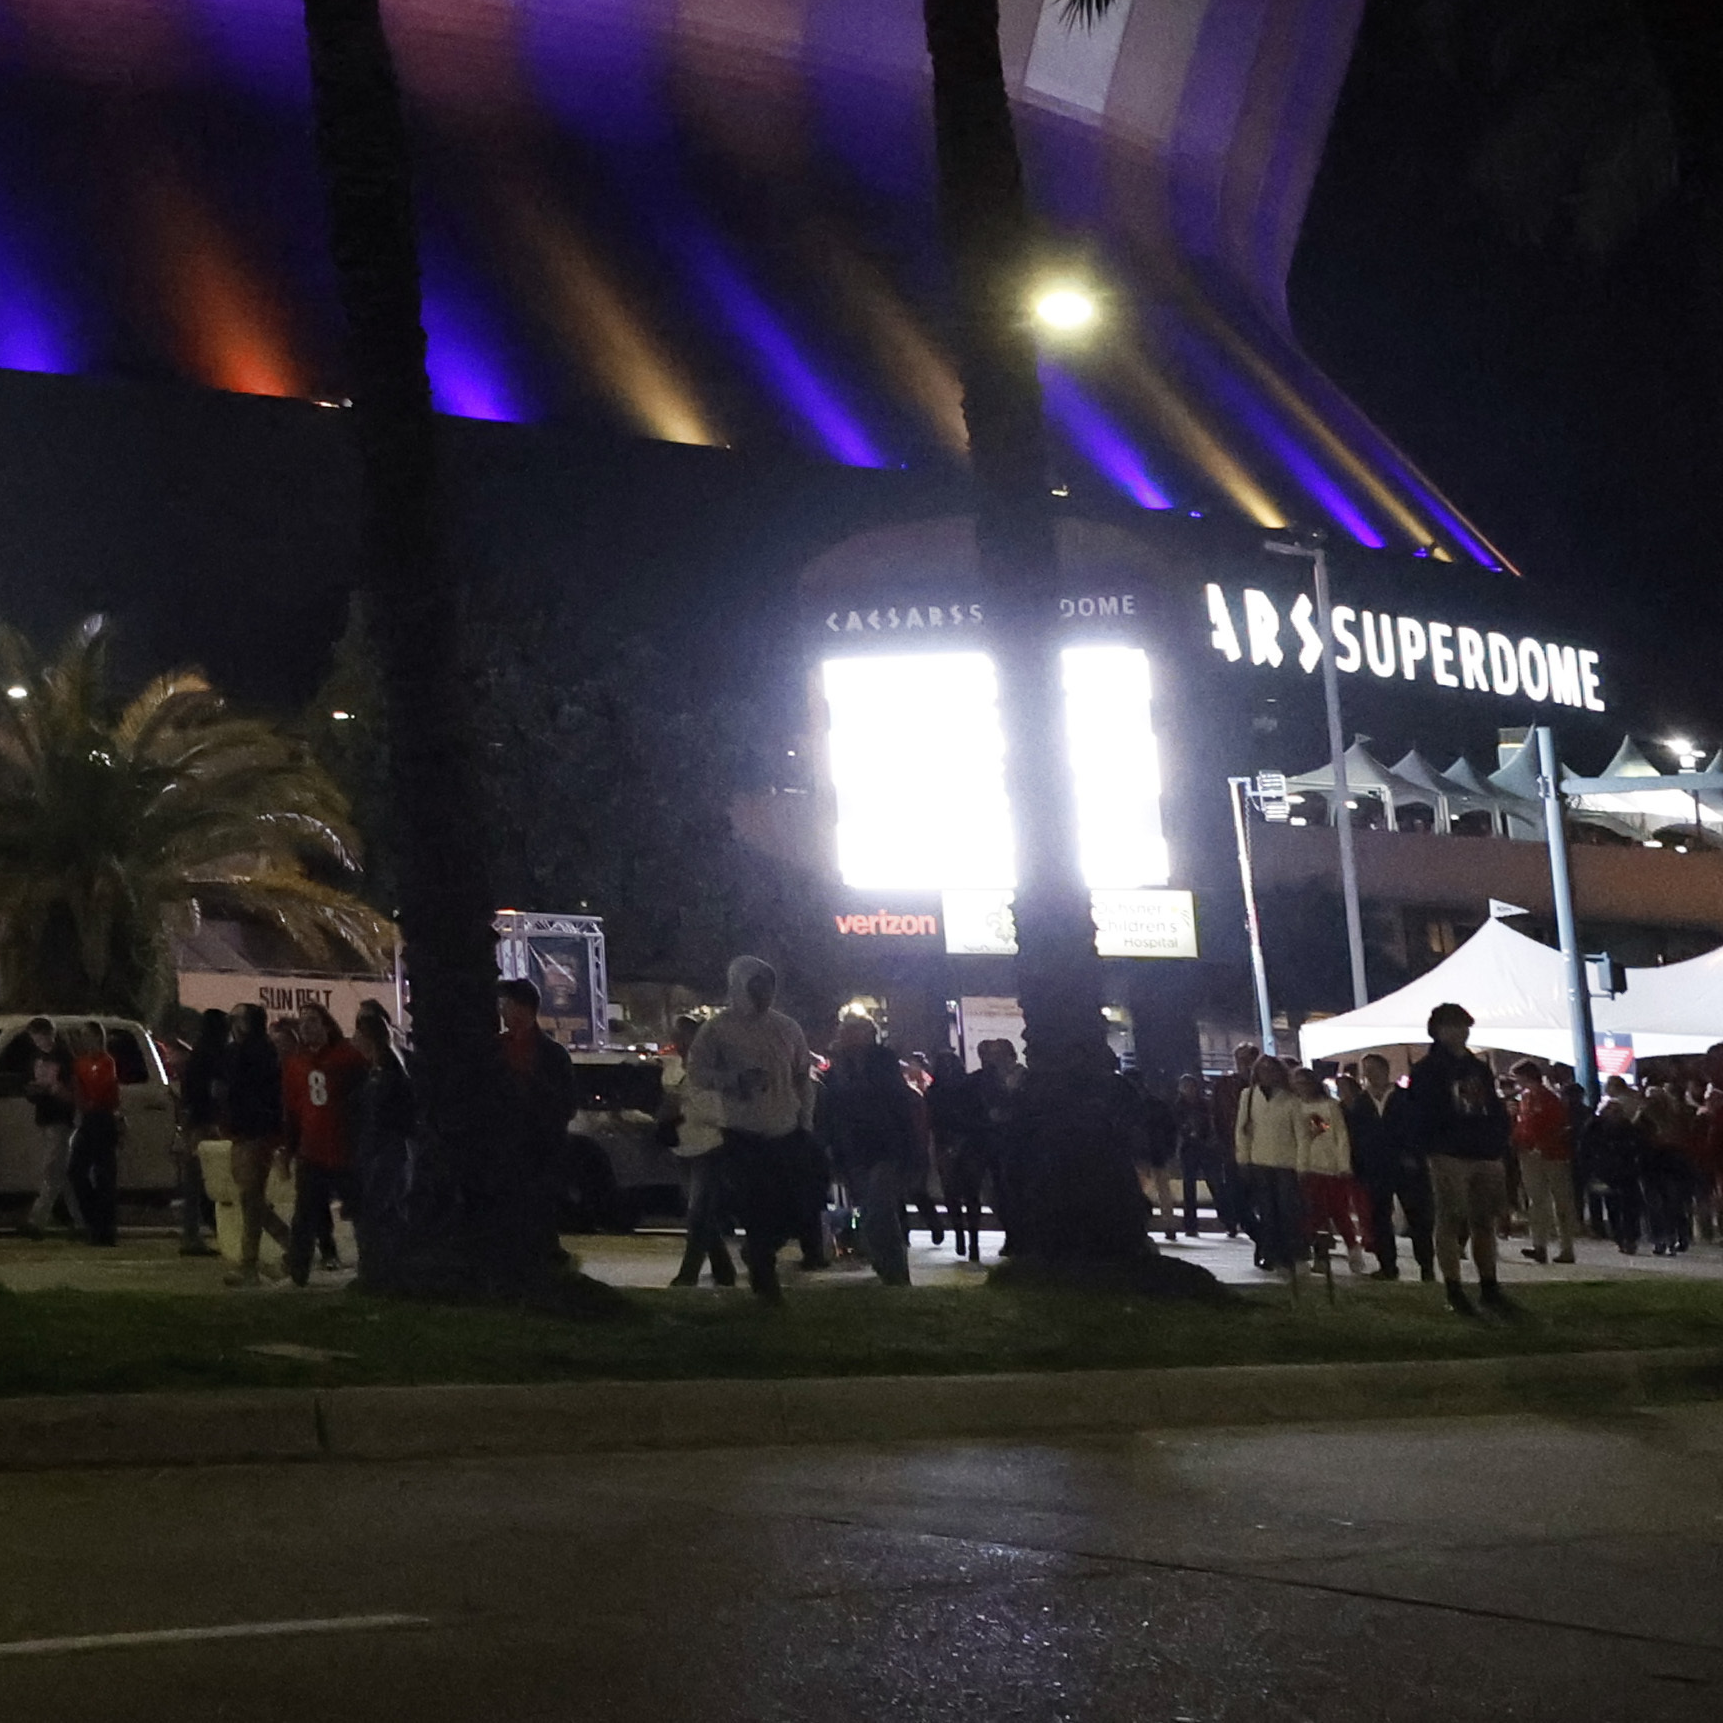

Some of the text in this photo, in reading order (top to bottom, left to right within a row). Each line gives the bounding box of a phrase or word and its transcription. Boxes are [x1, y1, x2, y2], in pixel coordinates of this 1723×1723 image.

[1331, 604, 1606, 713] SUPERDOME
[835, 909, 937, 935] verizon
[1097, 918, 1179, 933] Childrens
[1123, 936, 1179, 949] Hospital
[259, 986, 293, 1010] SUN
[307, 1069, 329, 1107] 8
